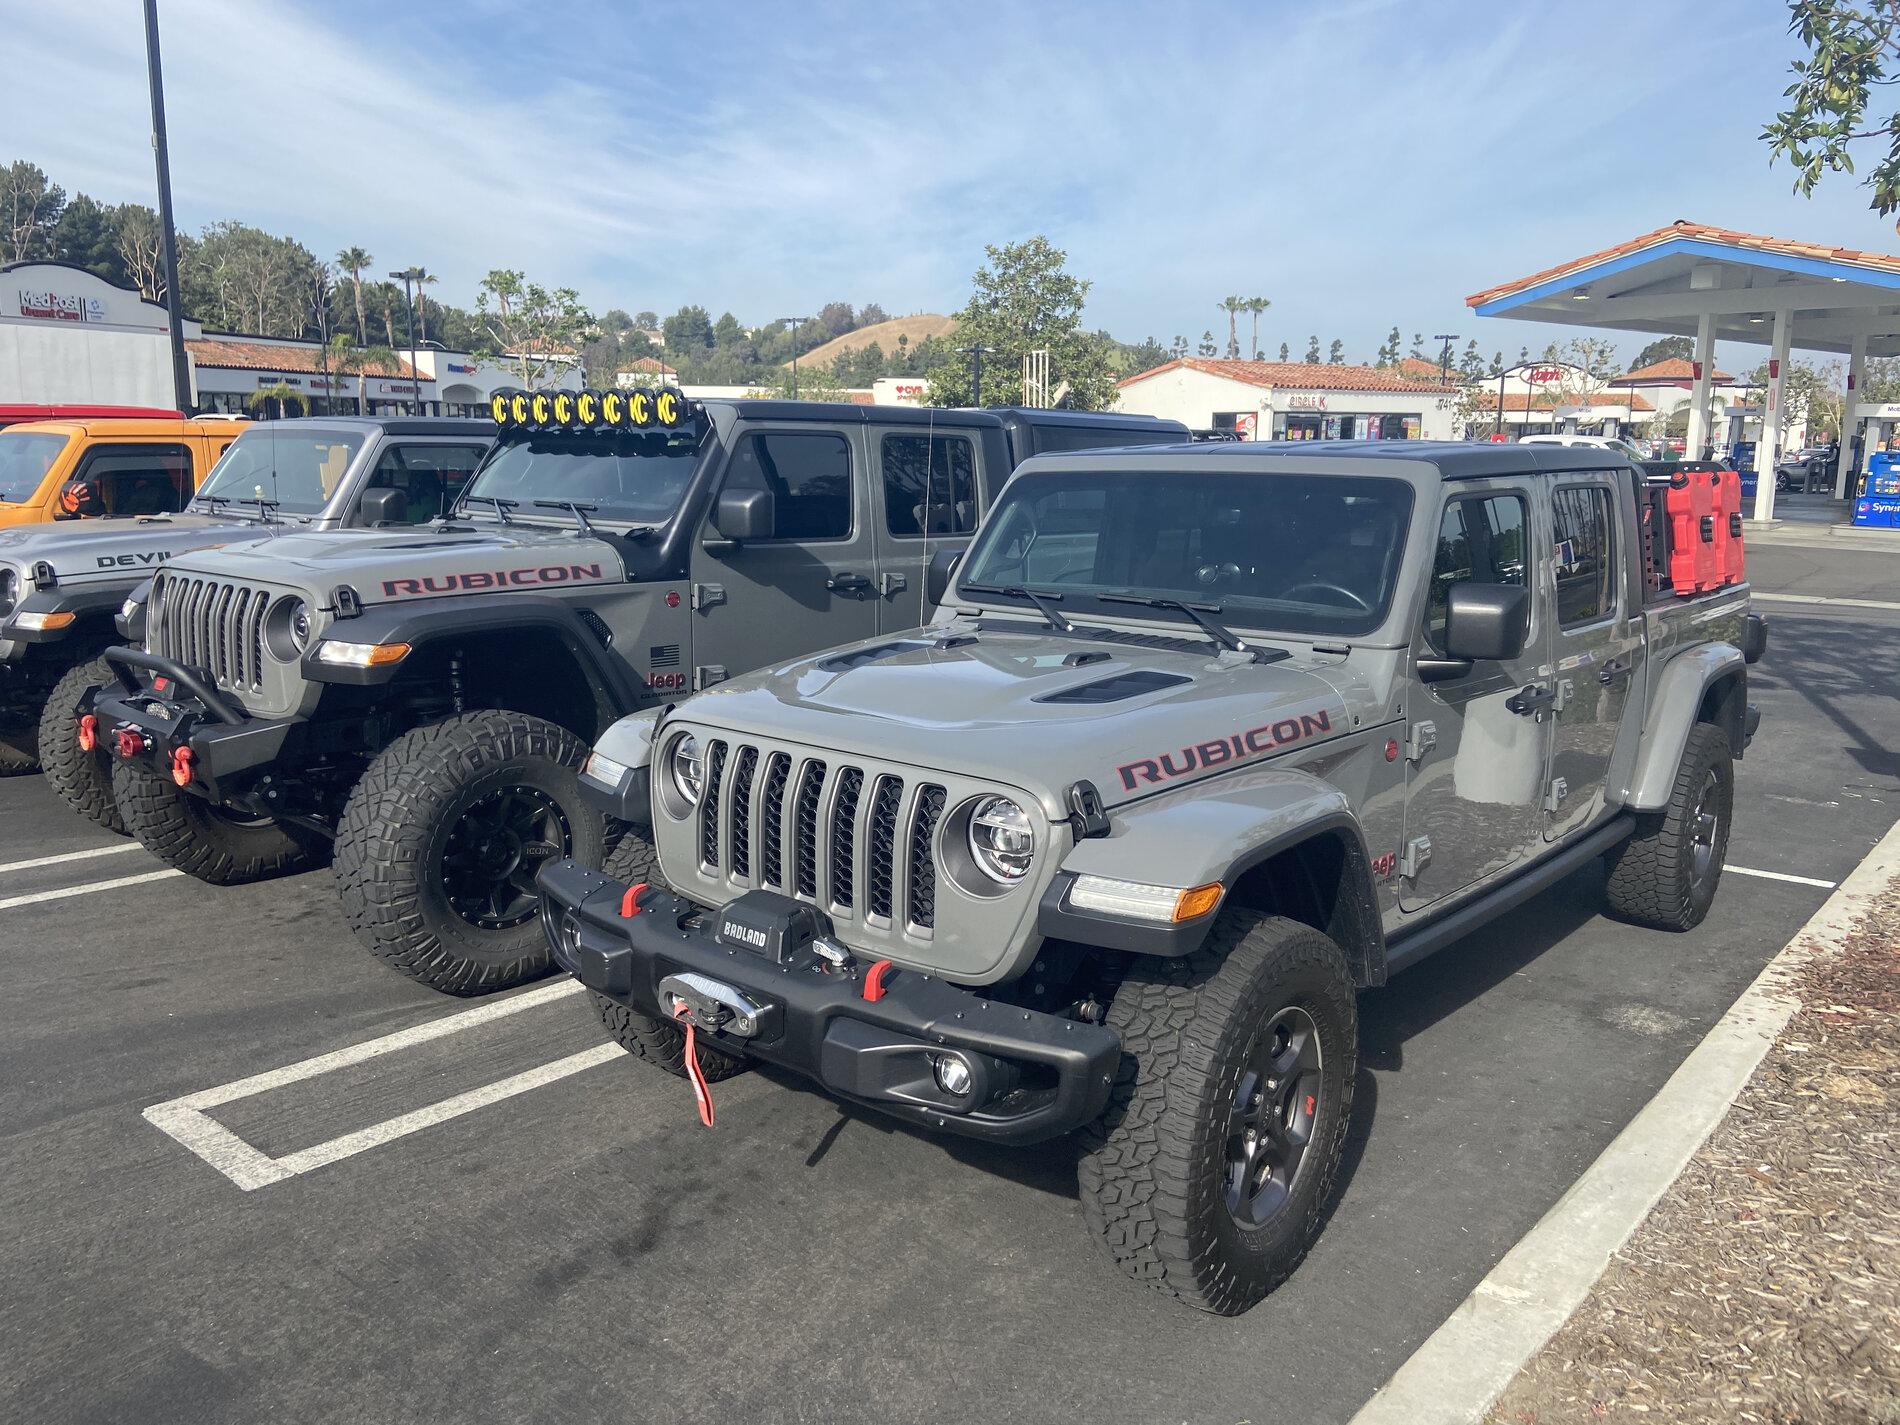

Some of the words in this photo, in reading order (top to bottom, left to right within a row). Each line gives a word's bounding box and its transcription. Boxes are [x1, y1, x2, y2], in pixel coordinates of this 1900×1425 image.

[19, 290, 80, 310] MedPost
[904, 385, 922, 395] CVS
[1289, 396, 1316, 407] CIRCLE
[1319, 396, 1326, 408] K
[493, 395, 506, 423] KC
[512, 395, 527, 423] KC
[533, 395, 548, 423] KC
[554, 394, 570, 423] KC
[578, 393, 595, 423] KC
[603, 393, 621, 424] KC
[629, 393, 648, 424] KC
[657, 392, 677, 424] KC
[381, 563, 603, 597] RUBICON
[643, 672, 687, 689] Jeep
[1117, 710, 1332, 791] RUBICON
[526, 847, 549, 856] ICON
[1371, 850, 1396, 877] eep
[723, 921, 767, 948] BADLAND
